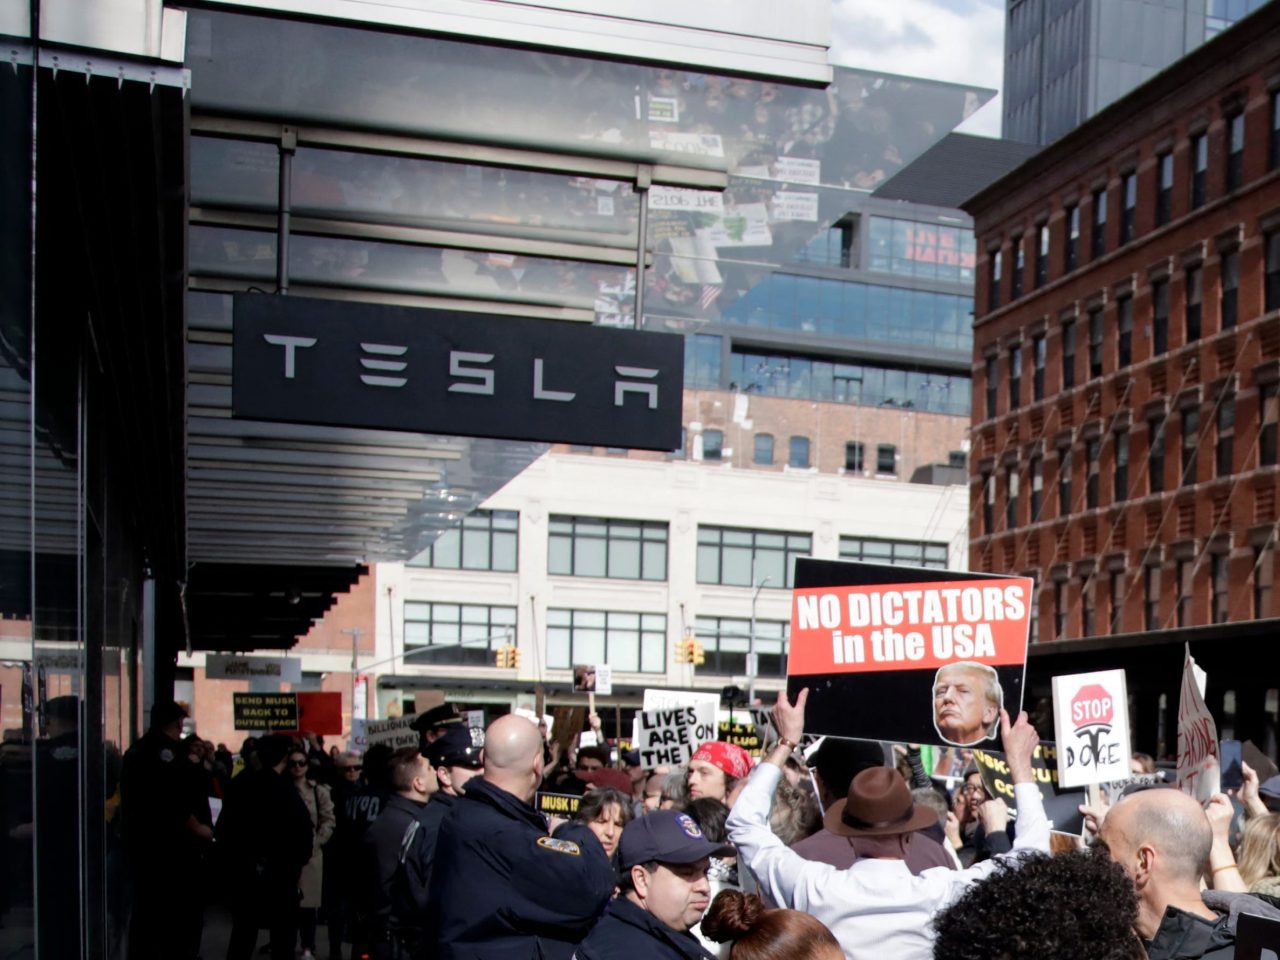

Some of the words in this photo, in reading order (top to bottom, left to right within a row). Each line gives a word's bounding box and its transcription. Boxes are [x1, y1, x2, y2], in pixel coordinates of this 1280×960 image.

[263, 333, 660, 409] TESLA
[797, 592, 842, 630] NO
[848, 585, 1026, 628] DICTATORS
[832, 630, 865, 664] in
[871, 628, 926, 663] the
[931, 623, 996, 660] USA
[275, 708, 288, 716] TO
[642, 706, 697, 730] LIVES
[1073, 697, 1112, 721] STOP
[648, 727, 688, 748] ARE
[695, 723, 714, 740] ON
[641, 747, 682, 766] THE
[541, 795, 569, 811] MUSK
